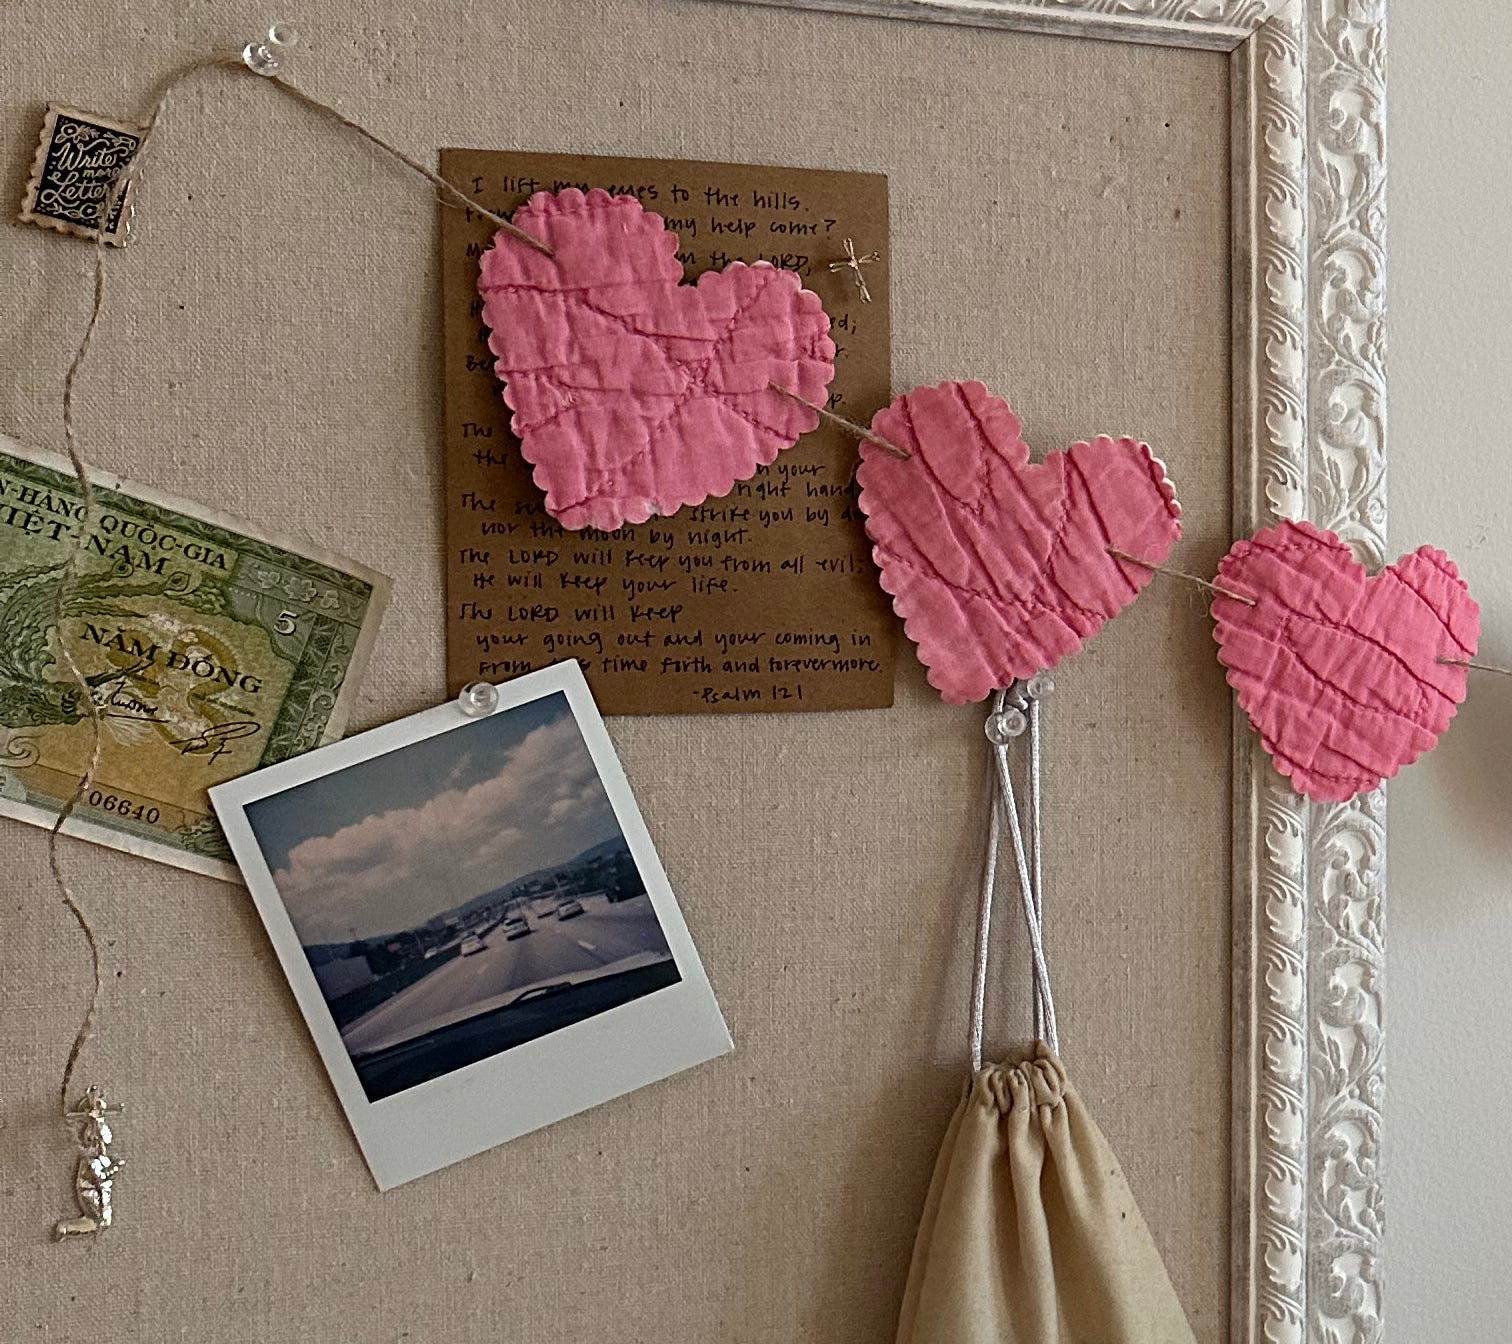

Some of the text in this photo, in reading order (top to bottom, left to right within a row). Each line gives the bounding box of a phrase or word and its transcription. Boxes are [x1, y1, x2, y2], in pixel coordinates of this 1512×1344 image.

[52, 139, 128, 170] Write
[471, 176, 484, 193] I
[502, 176, 540, 193] lift
[670, 184, 690, 203] to
[704, 186, 739, 207] the
[753, 190, 810, 212] hills.
[663, 216, 837, 240] my help come?
[461, 422, 493, 439] The
[473, 449, 507, 466] the
[778, 463, 826, 484] your
[461, 492, 496, 512] The
[689, 506, 750, 523] strike
[759, 510, 794, 528] you
[806, 506, 829, 526] by
[481, 521, 519, 536] nor
[649, 529, 675, 550] by
[688, 529, 753, 549] night.
[459, 548, 490, 565] The
[508, 549, 560, 566] LORD
[573, 548, 612, 566] will
[679, 555, 713, 573] you
[721, 556, 771, 573] from
[780, 556, 804, 574] all
[473, 573, 495, 589] He
[508, 571, 542, 589] will
[622, 579, 677, 601] your
[692, 577, 739, 594] life.
[273, 609, 298, 635] 5
[459, 602, 492, 620] The
[508, 603, 559, 623] LORD
[574, 603, 615, 621] will
[476, 627, 871, 654] your going out and your coming in
[602, 656, 648, 673] time
[660, 655, 713, 674] forth
[723, 657, 760, 673] and
[769, 657, 884, 674] forevermore.
[772, 685, 803, 700] 121
[89, 790, 161, 825] 06640
